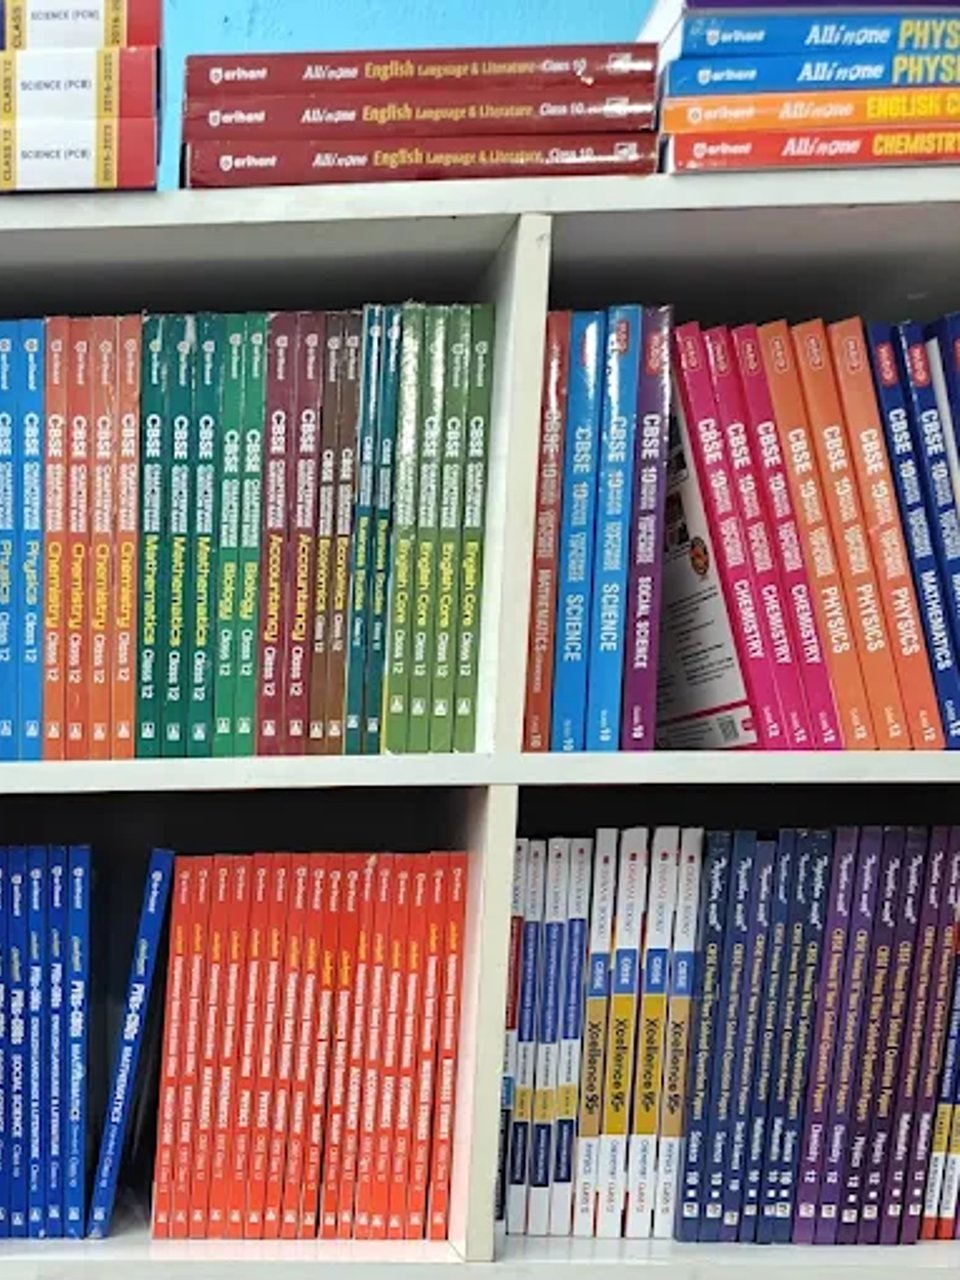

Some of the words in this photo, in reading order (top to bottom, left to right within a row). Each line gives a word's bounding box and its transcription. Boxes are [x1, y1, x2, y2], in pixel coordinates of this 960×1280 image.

[31, 11, 68, 20] SCIENCE
[21, 81, 61, 91] SCIENCE
[64, 80, 91, 91] (PCB)
[365, 62, 415, 80] English
[362, 105, 411, 124] English
[480, 105, 532, 118] Literature
[540, 104, 566, 115] Class
[866, 94, 940, 118] ENGLISH
[21, 151, 60, 159] SCIENCE
[574, 425, 592, 473] CBSE
[641, 413, 659, 459] CBSE
[788, 429, 812, 475] CBSE
[822, 587, 849, 654] PHYSICS
[889, 409, 911, 454] CBSE
[920, 571, 952, 671] MATHEMATICS
[564, 594, 584, 661] SCIENCE
[601, 583, 619, 651] SCIENCE
[734, 580, 763, 659] CHEMISTRY
[791, 583, 820, 664] CHEMISTRY
[857, 583, 883, 652] PHYSICS
[892, 589, 919, 656] PHYSICS
[588, 1021, 601, 1091] Xcellence
[643, 1018, 658, 1089] Xcellence
[669, 1021, 684, 1091] Xcellence
